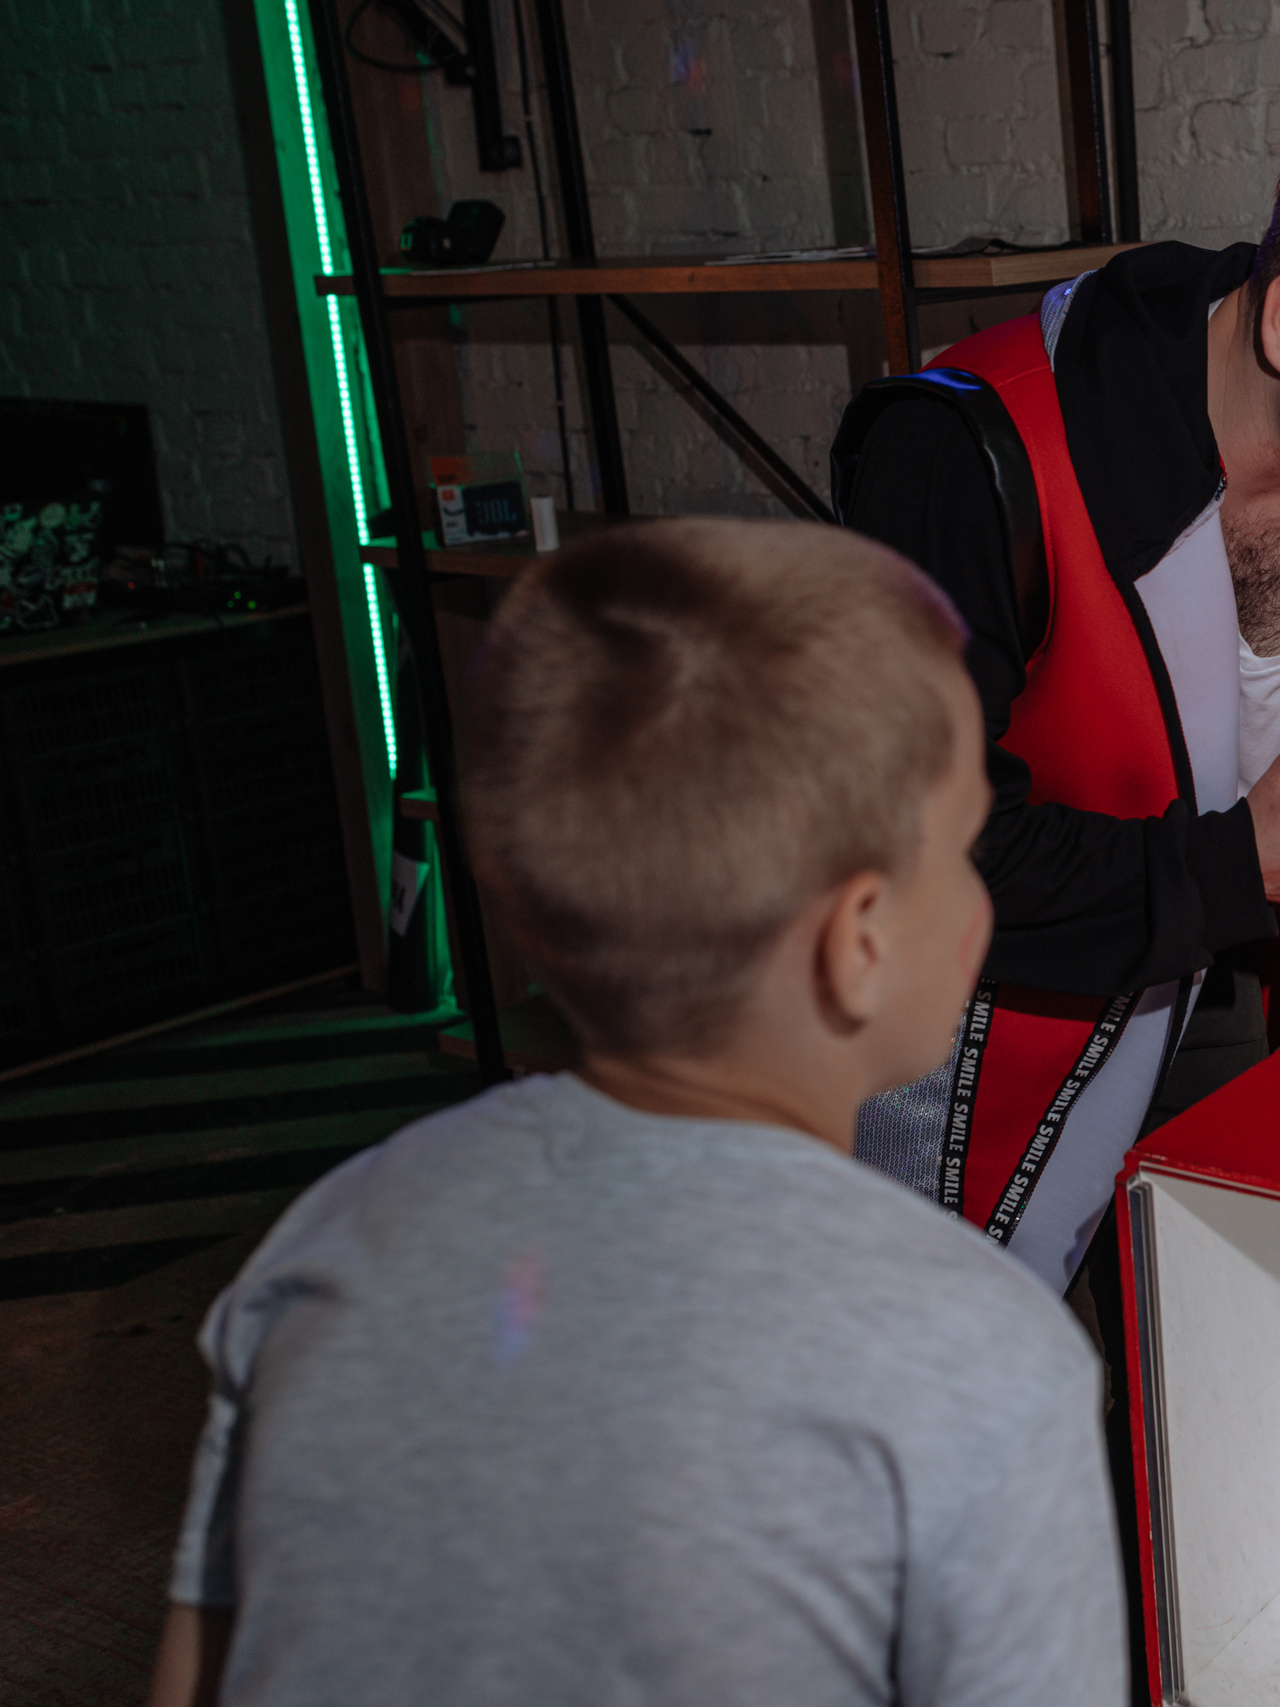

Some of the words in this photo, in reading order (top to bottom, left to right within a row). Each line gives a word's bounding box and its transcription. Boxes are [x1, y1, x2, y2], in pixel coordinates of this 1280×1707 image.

[475, 497, 519, 526] JBL
[968, 990, 993, 1042] SMILE
[1099, 990, 1135, 1034] MILE
[956, 1046, 979, 1098] SMILE
[1074, 1034, 1110, 1079] SMILE
[1046, 1079, 1082, 1123] SMILE
[948, 1102, 969, 1153] SMILE
[1020, 1123, 1055, 1174] SMILE
[943, 1156, 961, 1205] SMILE
[994, 1173, 1030, 1226] SMILE
